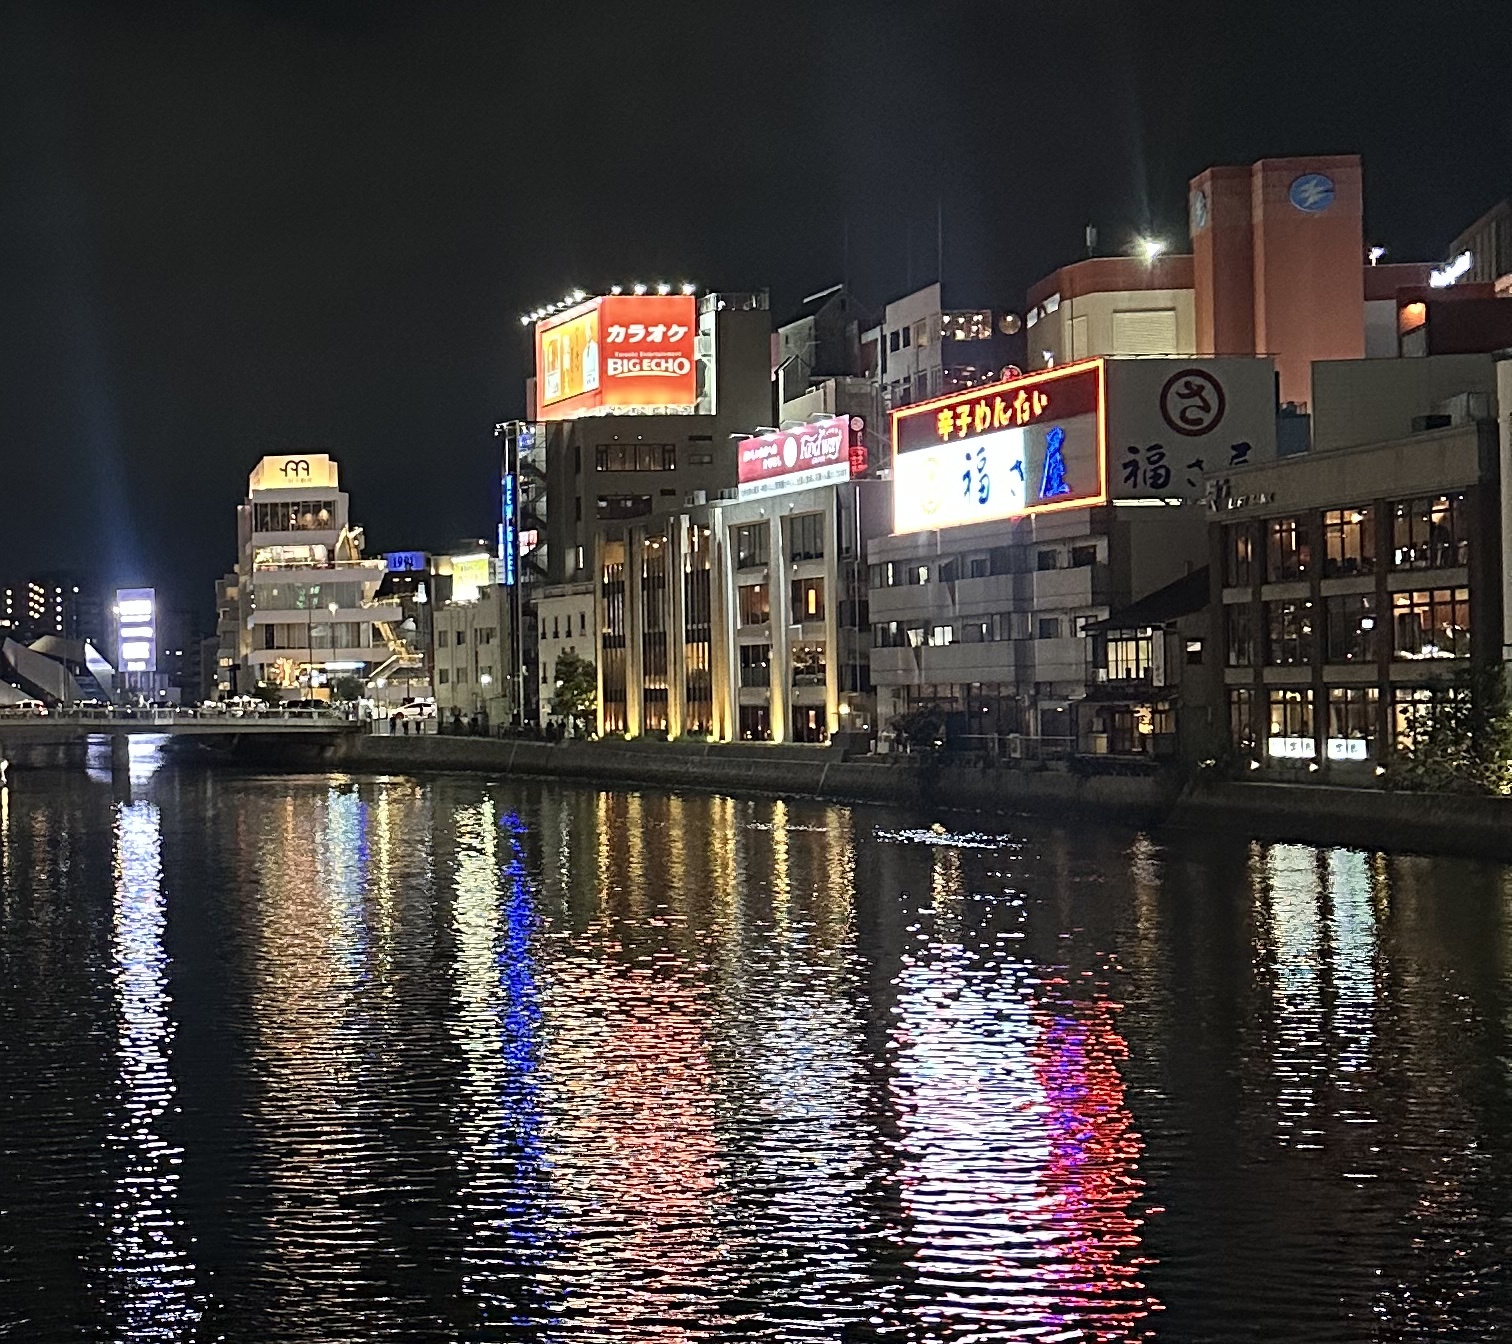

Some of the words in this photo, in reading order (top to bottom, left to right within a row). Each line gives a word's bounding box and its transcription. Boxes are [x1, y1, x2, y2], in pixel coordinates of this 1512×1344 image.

[606, 323, 688, 343] カラオケ
[607, 358, 641, 376] BIG
[642, 357, 691, 375] ECHO
[937, 389, 1049, 441] 辛子めんたい
